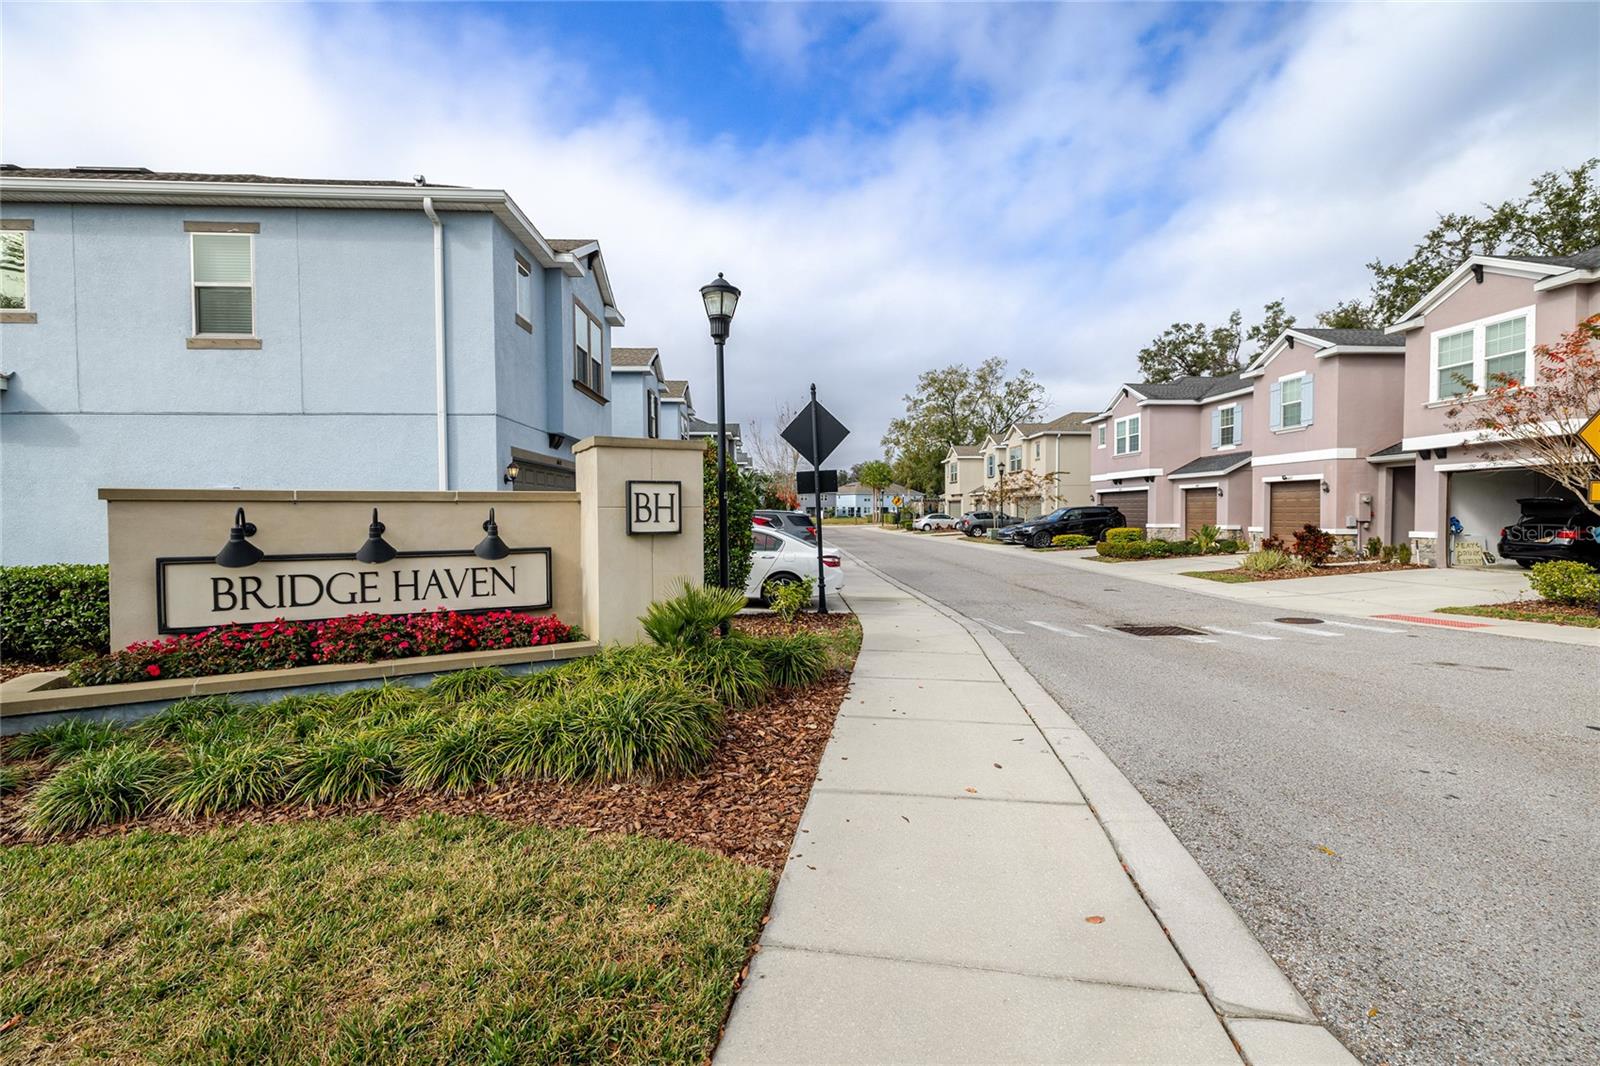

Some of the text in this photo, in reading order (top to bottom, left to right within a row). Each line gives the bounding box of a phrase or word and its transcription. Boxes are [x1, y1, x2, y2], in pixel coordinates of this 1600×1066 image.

[633, 492, 676, 524] BH
[211, 566, 516, 612] BRIDGE HAVEN
